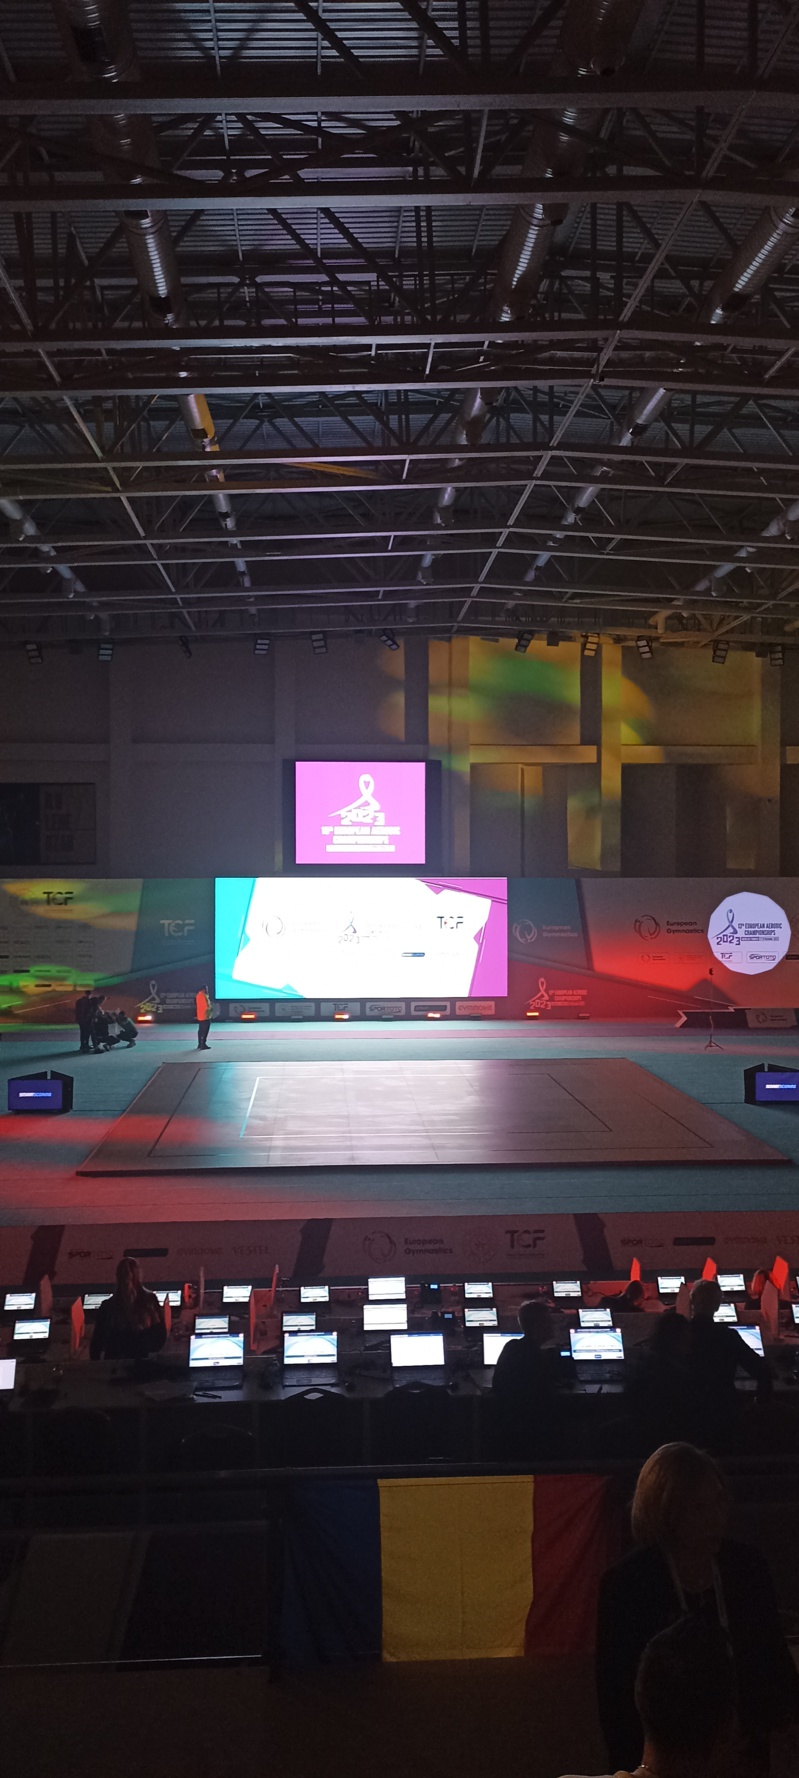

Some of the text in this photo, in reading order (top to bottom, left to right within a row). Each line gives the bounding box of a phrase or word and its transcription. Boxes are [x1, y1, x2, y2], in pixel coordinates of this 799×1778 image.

[341, 808, 386, 826] 2023
[43, 891, 74, 906] TCF
[159, 919, 196, 937] TCF
[436, 915, 464, 930] TCF
[666, 920, 698, 928] European
[745, 922, 766, 930] EUROPEAN
[666, 928, 705, 936] Gymnastics
[716, 934, 741, 946] 2023
[720, 952, 733, 960] TCF
[140, 1002, 163, 1013] 2023
[530, 999, 552, 1010] 2023
[404, 1237, 444, 1247] European
[504, 1229, 546, 1250] TCF
[404, 1247, 454, 1257] Gymnastics
